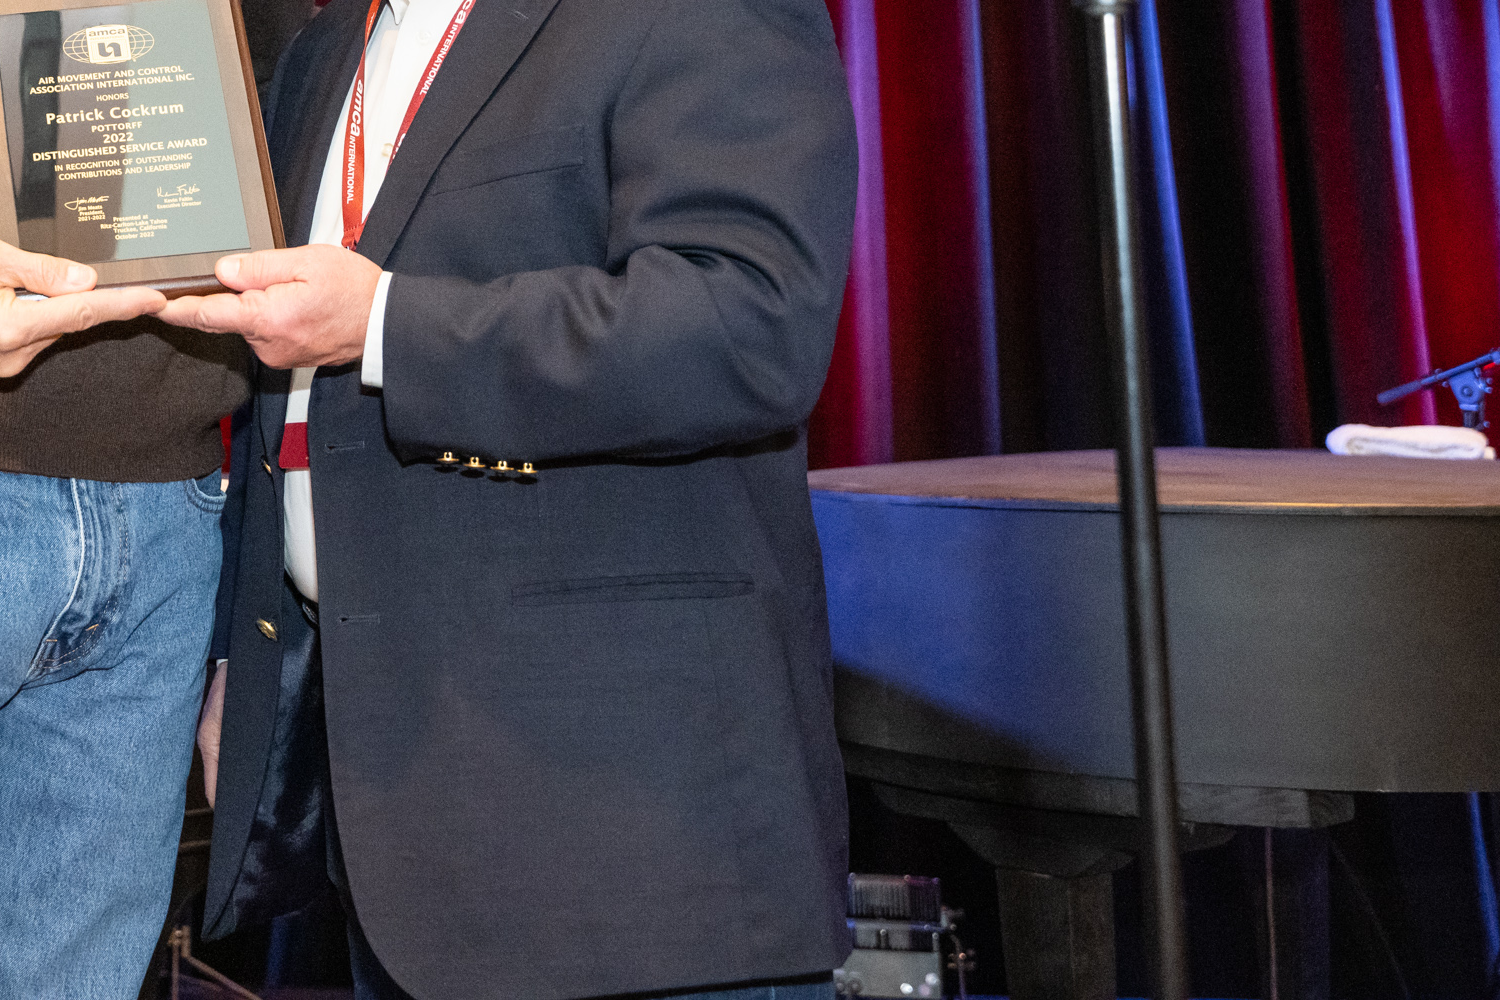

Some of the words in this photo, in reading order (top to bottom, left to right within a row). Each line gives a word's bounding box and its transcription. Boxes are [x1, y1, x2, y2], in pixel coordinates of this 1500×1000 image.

[420, 24, 458, 95] INTERNATIONAL
[30, 82, 94, 95] ASSOCIATION
[96, 76, 173, 88] INTERNATIONAL
[176, 73, 194, 82] INC.
[38, 76, 55, 85] AIR
[57, 72, 111, 83] MOVEMENT
[114, 70, 134, 78] AND
[138, 65, 184, 76] CONTROL
[96, 92, 129, 102] HONORS
[46, 108, 104, 124] Patrick
[110, 104, 184, 119] Cockrum
[350, 80, 364, 136] amca
[91, 122, 142, 132] POTTORFF
[102, 132, 134, 144] 2022
[32, 145, 116, 162] DISTINGUISHED
[120, 142, 164, 154] SERVICE
[167, 138, 208, 150] AWARD
[58, 168, 122, 181] CONTRIBUTIONS
[145, 162, 190, 172] LEADERSHIP
[66, 160, 120, 171] RECOGNITION
[136, 152, 192, 164] OUTSTANDING
[346, 136, 356, 204] INTERNATIONAL
